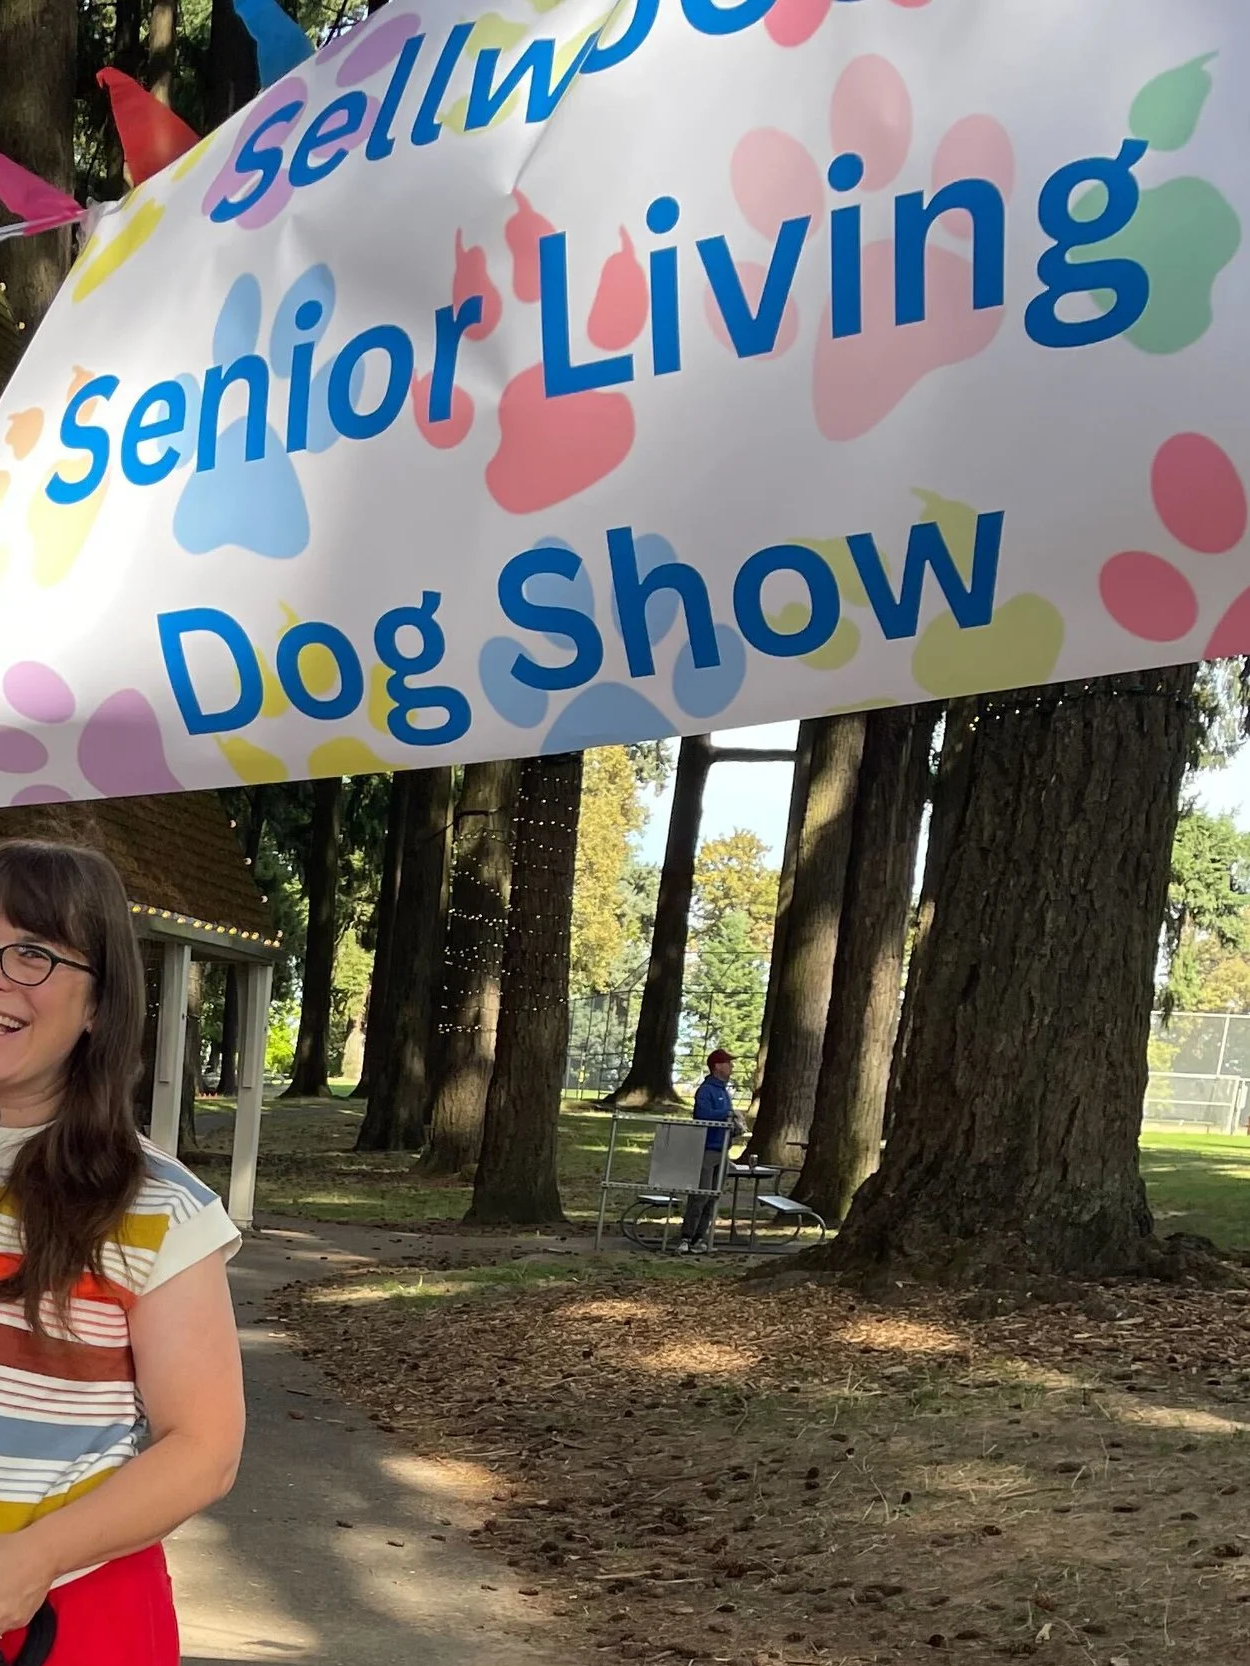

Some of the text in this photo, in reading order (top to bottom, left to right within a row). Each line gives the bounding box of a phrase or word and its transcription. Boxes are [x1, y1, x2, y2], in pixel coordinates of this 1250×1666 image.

[45, 138, 1150, 505] Senior Living
[156, 509, 1005, 747] Dog Show
